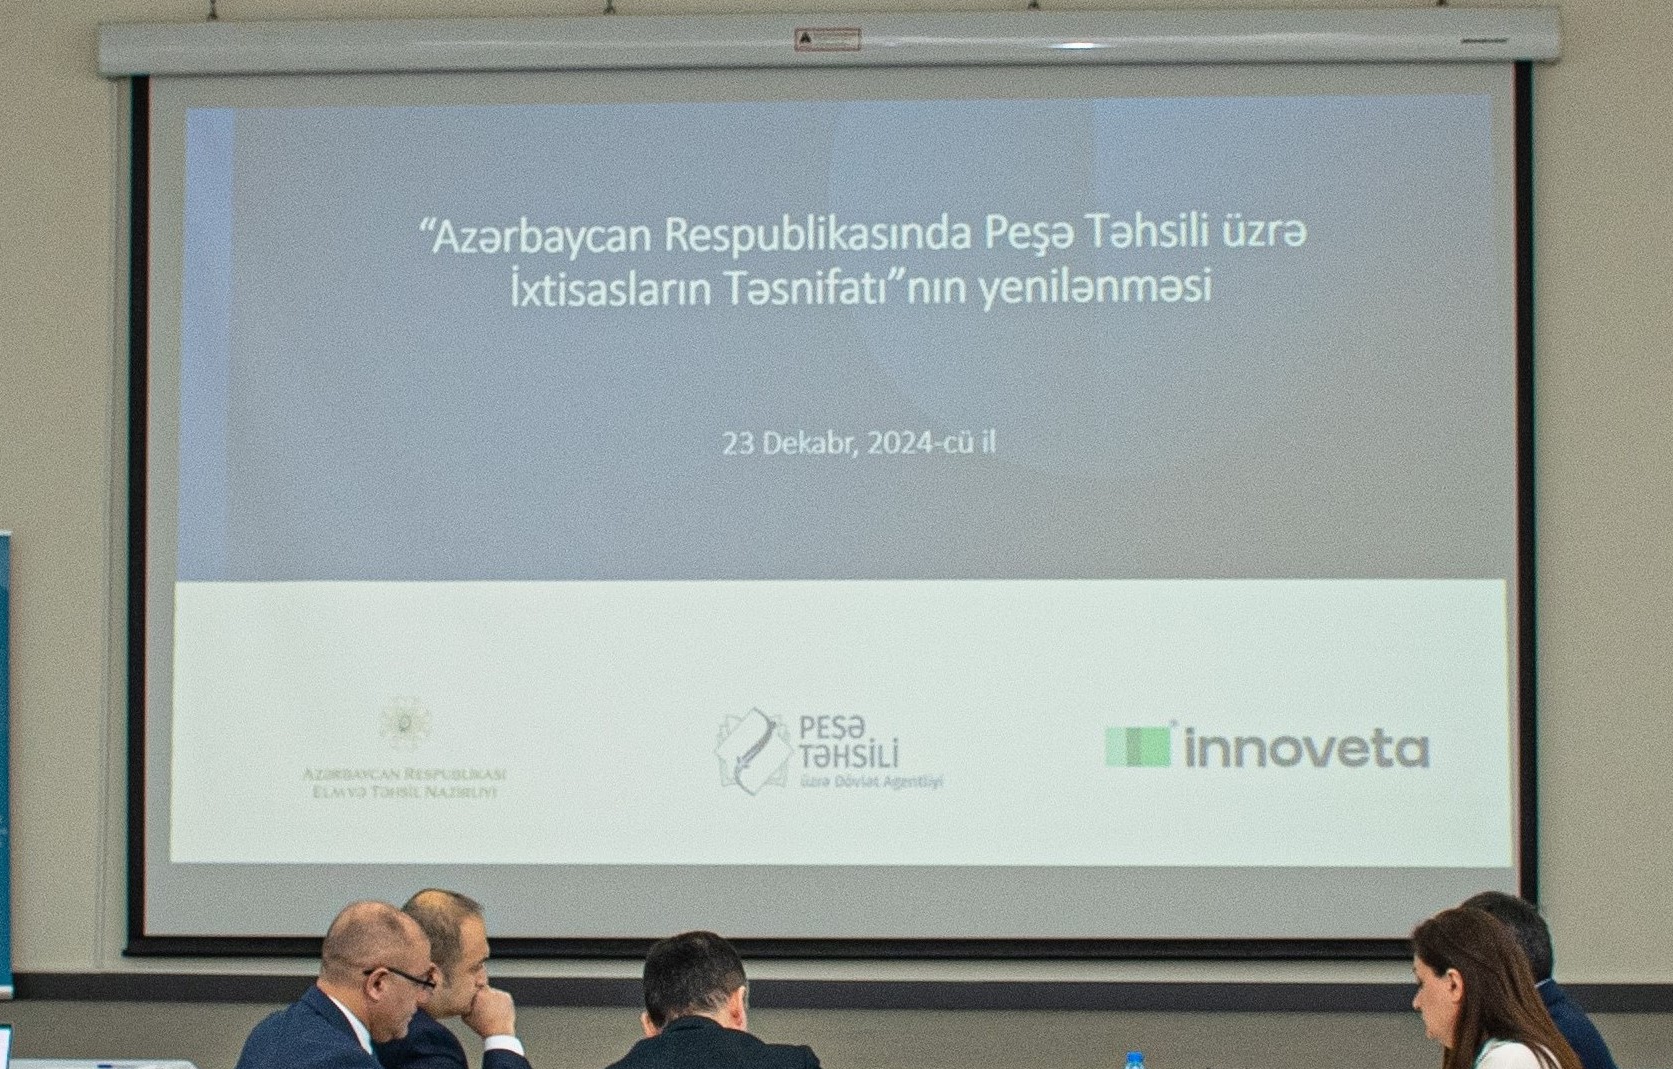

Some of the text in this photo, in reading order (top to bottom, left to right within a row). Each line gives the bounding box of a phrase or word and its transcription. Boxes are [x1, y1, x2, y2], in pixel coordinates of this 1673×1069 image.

[666, 213, 971, 259] Respublikasında
[986, 214, 1074, 257] Peşə
[1085, 210, 1211, 249] Təhsili
[1223, 213, 1307, 247] üzrə
[512, 264, 711, 306] İxtisasların
[978, 266, 1211, 312] yenilənməsi
[723, 429, 996, 459] 23 Dekabr, 2024-cü il
[800, 714, 866, 741] PEŞƏ
[798, 737, 899, 768] TƏHSİLİ
[1185, 726, 1430, 768] innoveta
